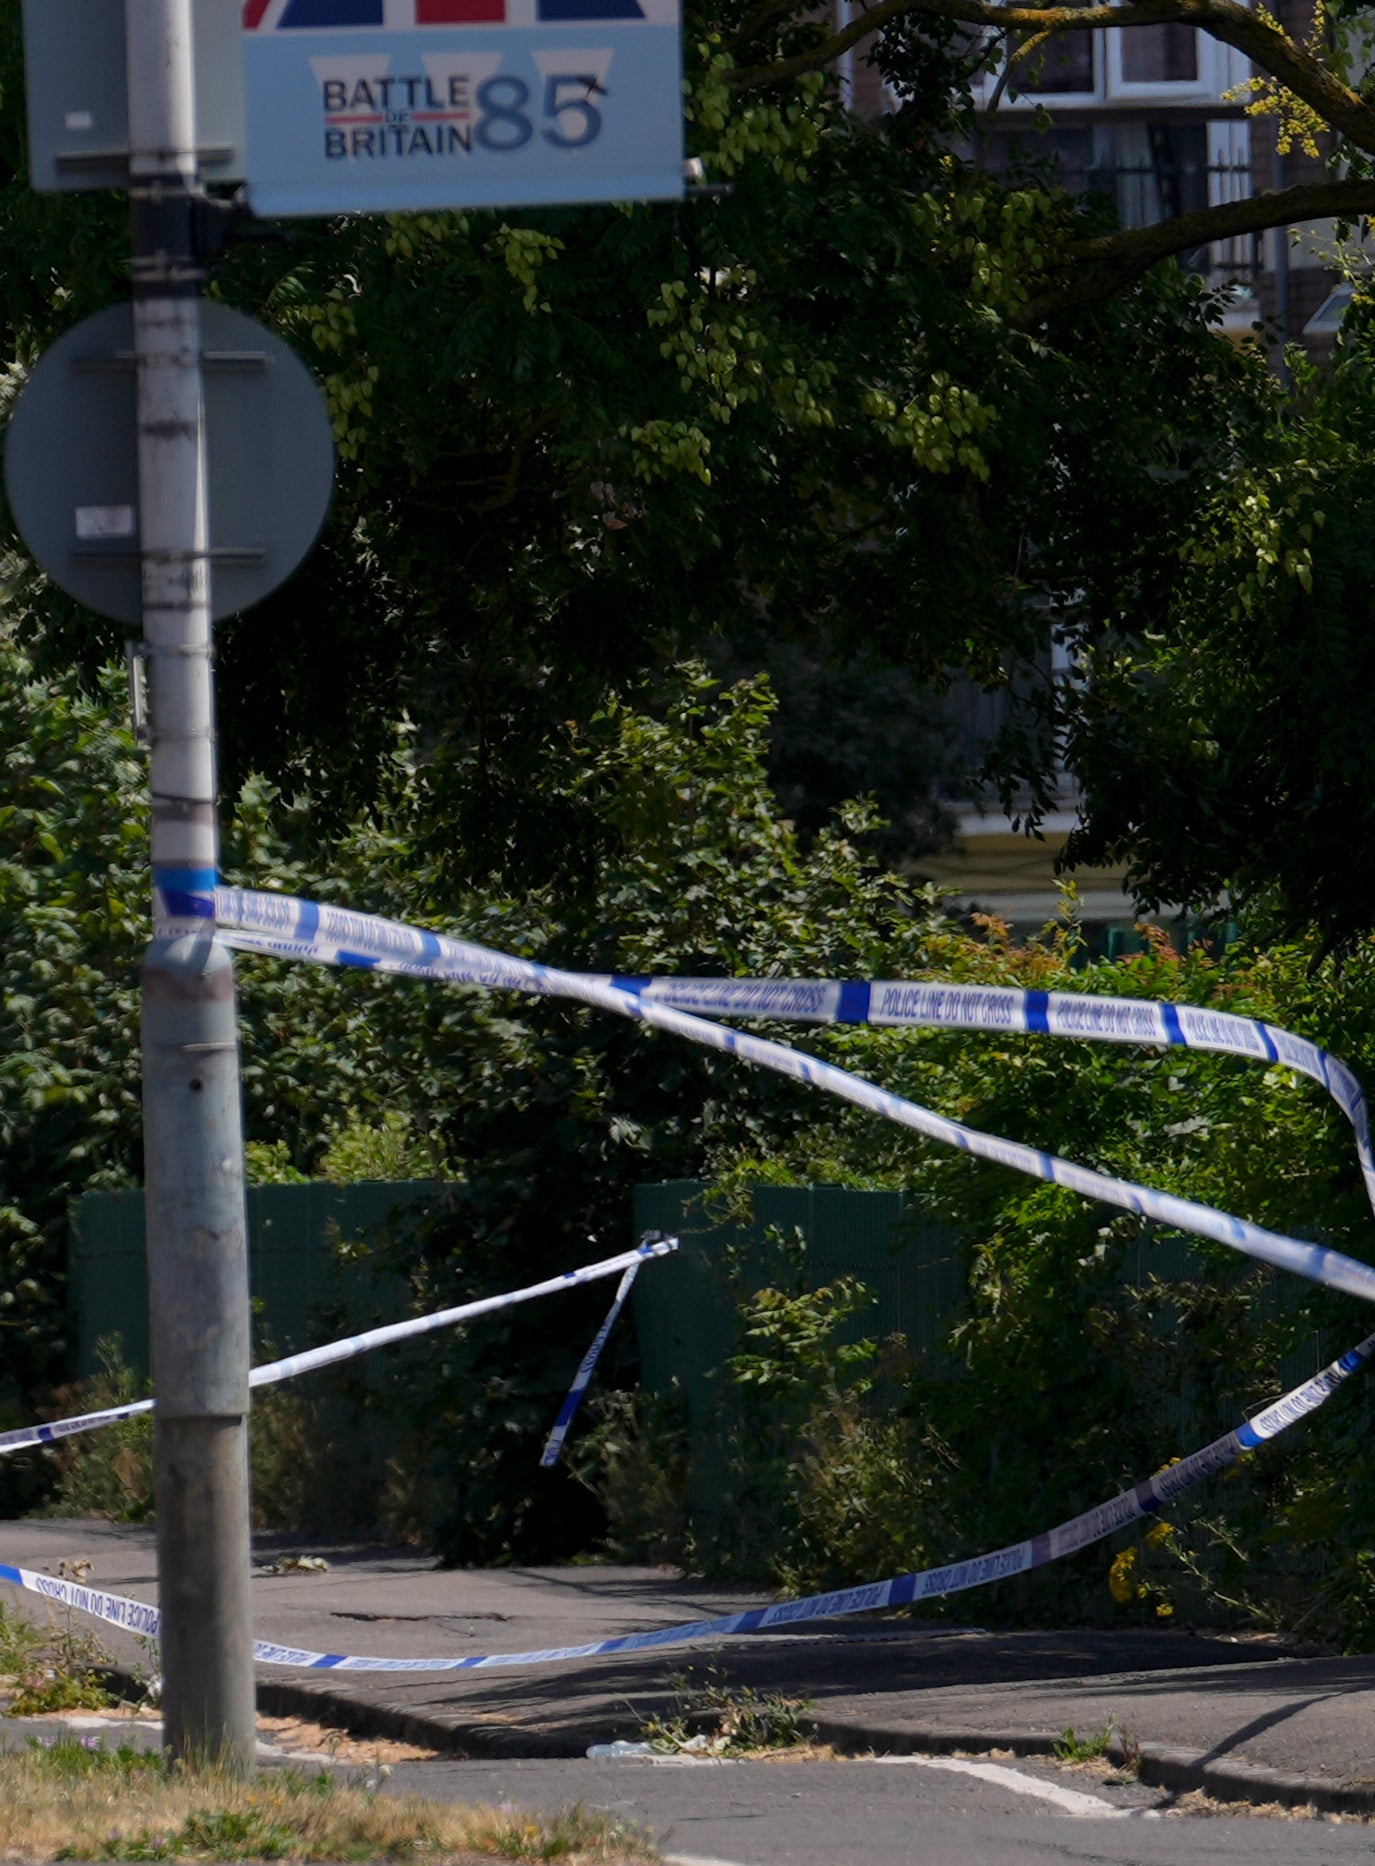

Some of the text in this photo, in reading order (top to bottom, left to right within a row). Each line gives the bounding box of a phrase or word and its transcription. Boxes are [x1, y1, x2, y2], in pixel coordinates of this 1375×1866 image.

[323, 74, 471, 111] BATTLE
[386, 109, 410, 124] OF
[474, 74, 605, 152] 85
[325, 124, 472, 161] BRITAIN
[880, 988, 1014, 1024] POLICE LINE DO NOT CROSS
[91, 1593, 104, 1616] DO
[105, 1597, 126, 1625] LINE
[127, 1603, 162, 1634] POLICE
